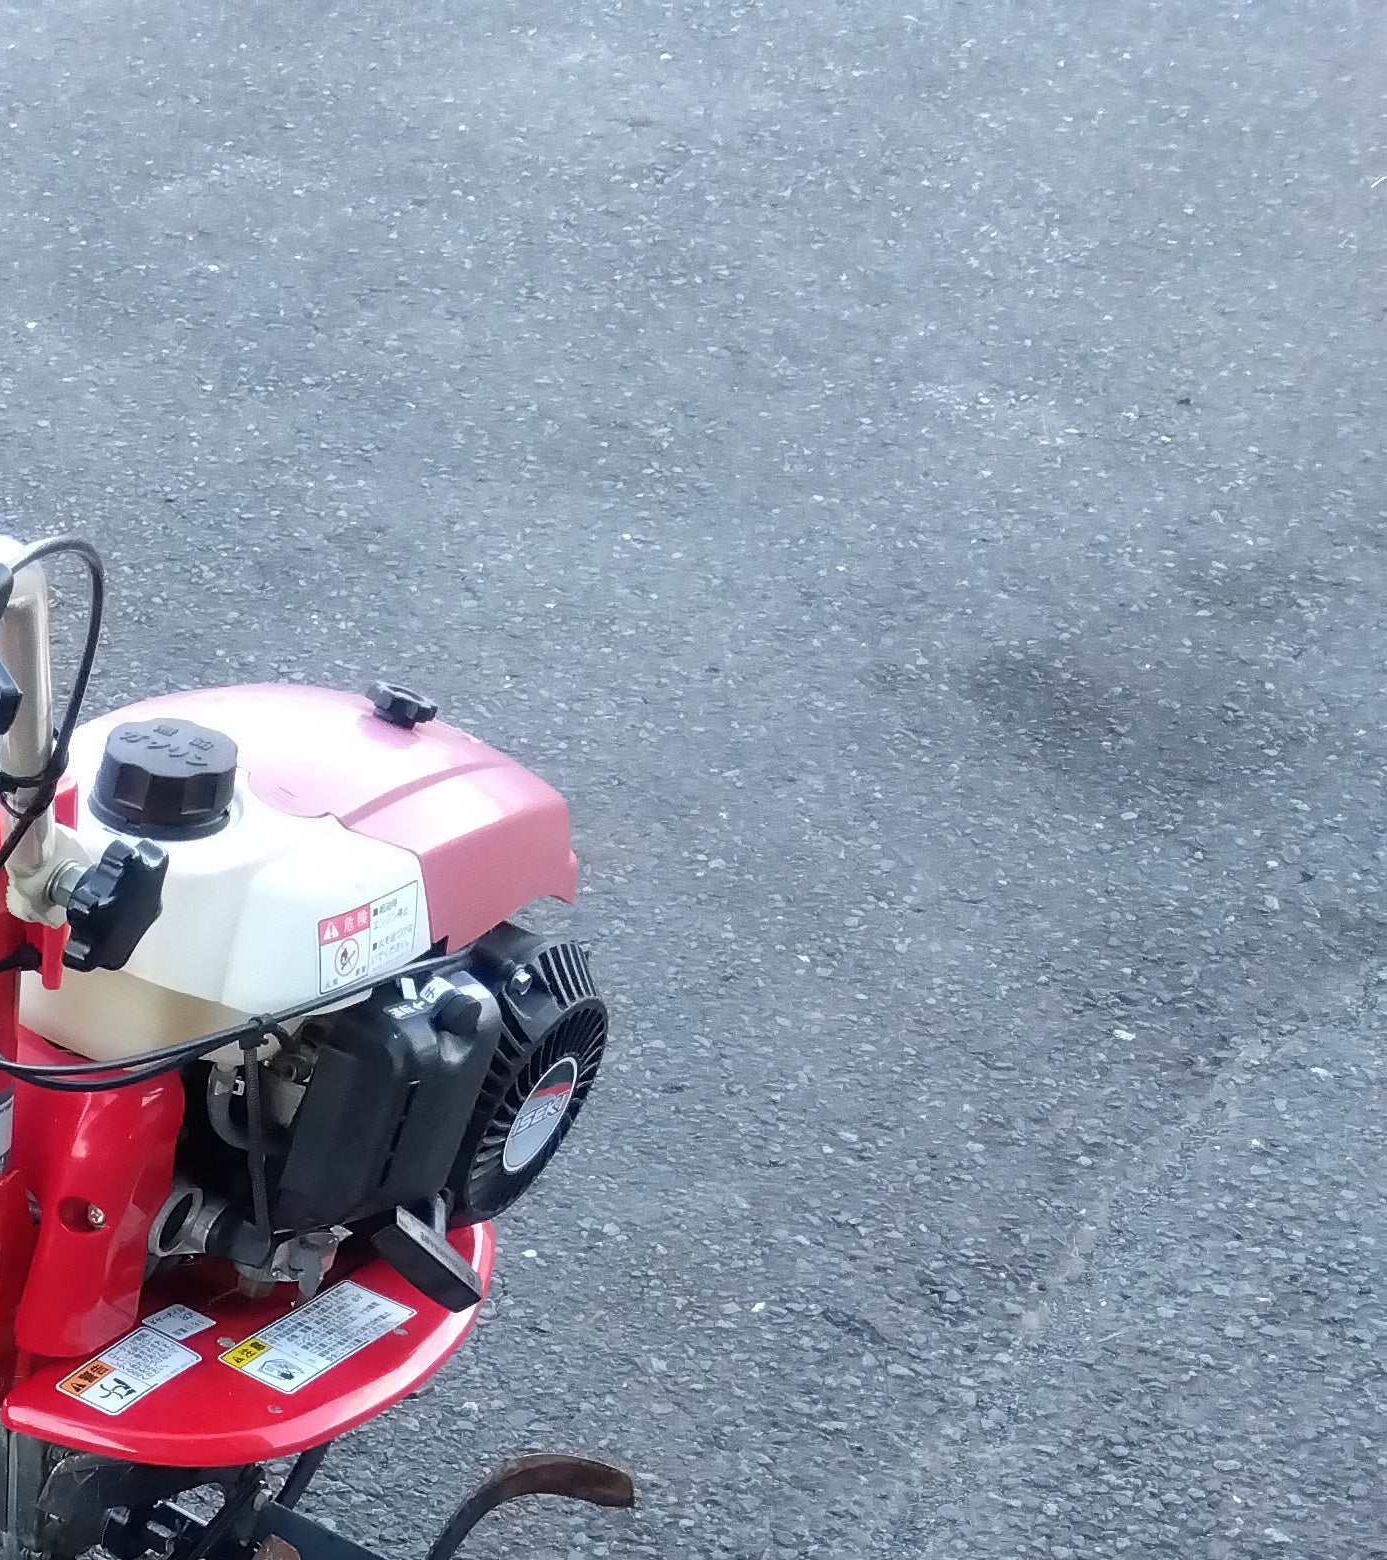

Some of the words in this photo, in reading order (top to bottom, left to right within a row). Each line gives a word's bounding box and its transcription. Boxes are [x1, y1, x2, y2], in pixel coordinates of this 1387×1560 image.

[343, 908, 368, 933] 危険
[510, 1089, 571, 1138] ISEKI
[240, 1341, 267, 1359] 注意
[77, 1364, 110, 1384] 警告
